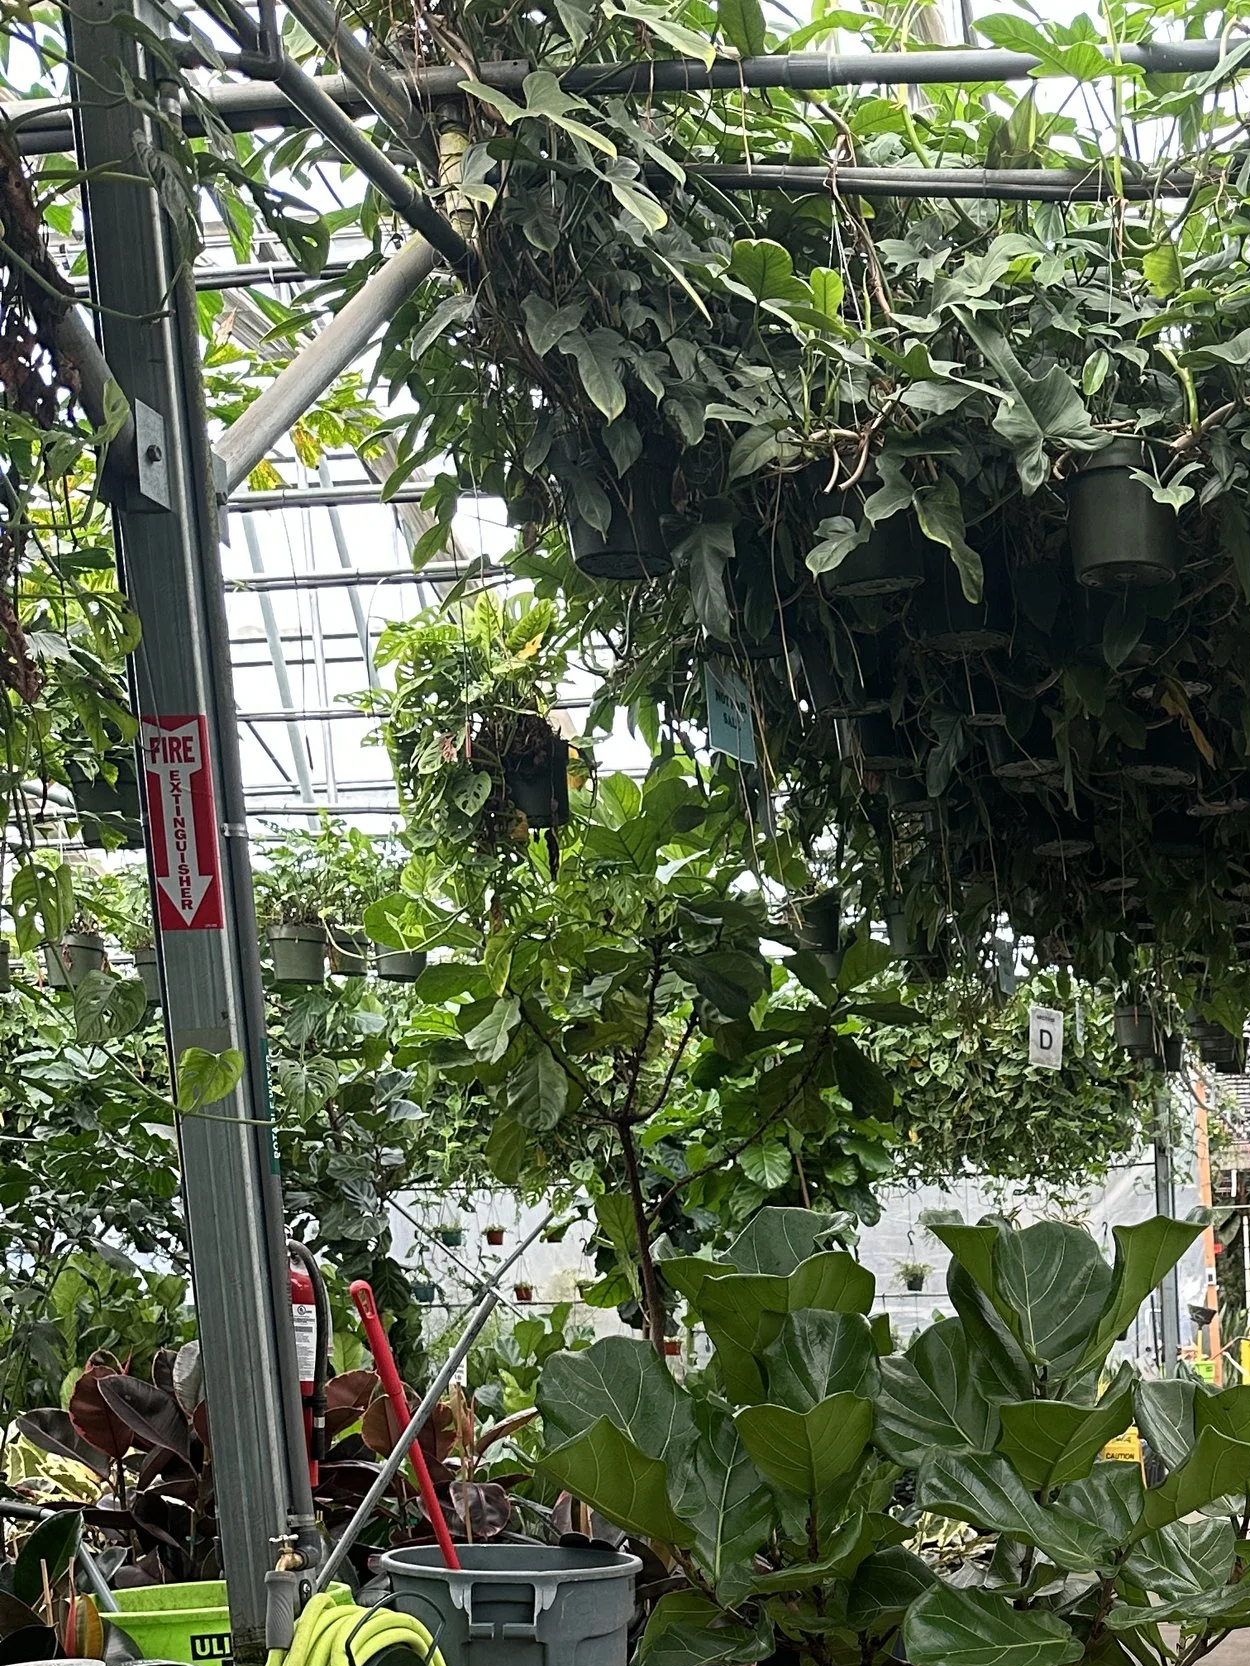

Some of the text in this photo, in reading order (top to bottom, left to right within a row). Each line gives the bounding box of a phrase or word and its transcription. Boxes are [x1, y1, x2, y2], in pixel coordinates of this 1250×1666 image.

[150, 736, 195, 764] FIRE
[169, 770, 194, 911] EXTINGUISHER
[1040, 1029, 1052, 1049] D
